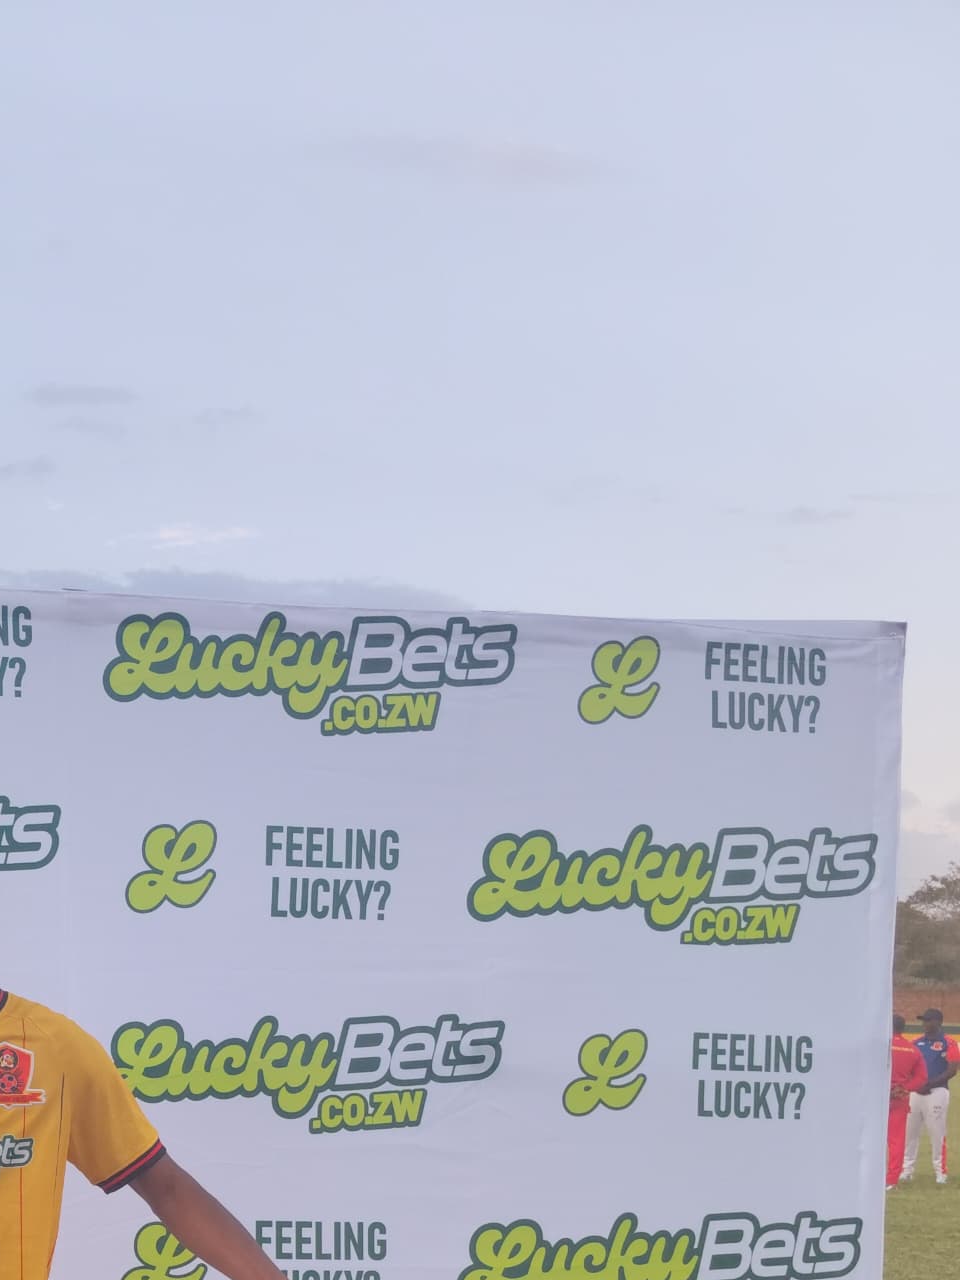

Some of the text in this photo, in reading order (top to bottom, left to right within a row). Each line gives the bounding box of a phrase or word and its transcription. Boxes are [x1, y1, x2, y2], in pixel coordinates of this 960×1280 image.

[103, 611, 517, 720] LuckyBets
[704, 641, 827, 686] FEELING
[321, 691, 441, 736] .CO.ZW
[711, 690, 820, 734] LUCKY?
[265, 825, 400, 871] FEELING
[270, 877, 391, 921] LUCKY?
[467, 825, 878, 931] LuckyBets
[681, 903, 800, 945] .CO.ZW
[111, 1014, 505, 1119] LuckyBets
[691, 1031, 813, 1075] FEELING
[310, 1089, 427, 1134] .CO.ZW
[696, 1079, 806, 1120] LUCKY?
[255, 1220, 387, 1261] FEELING
